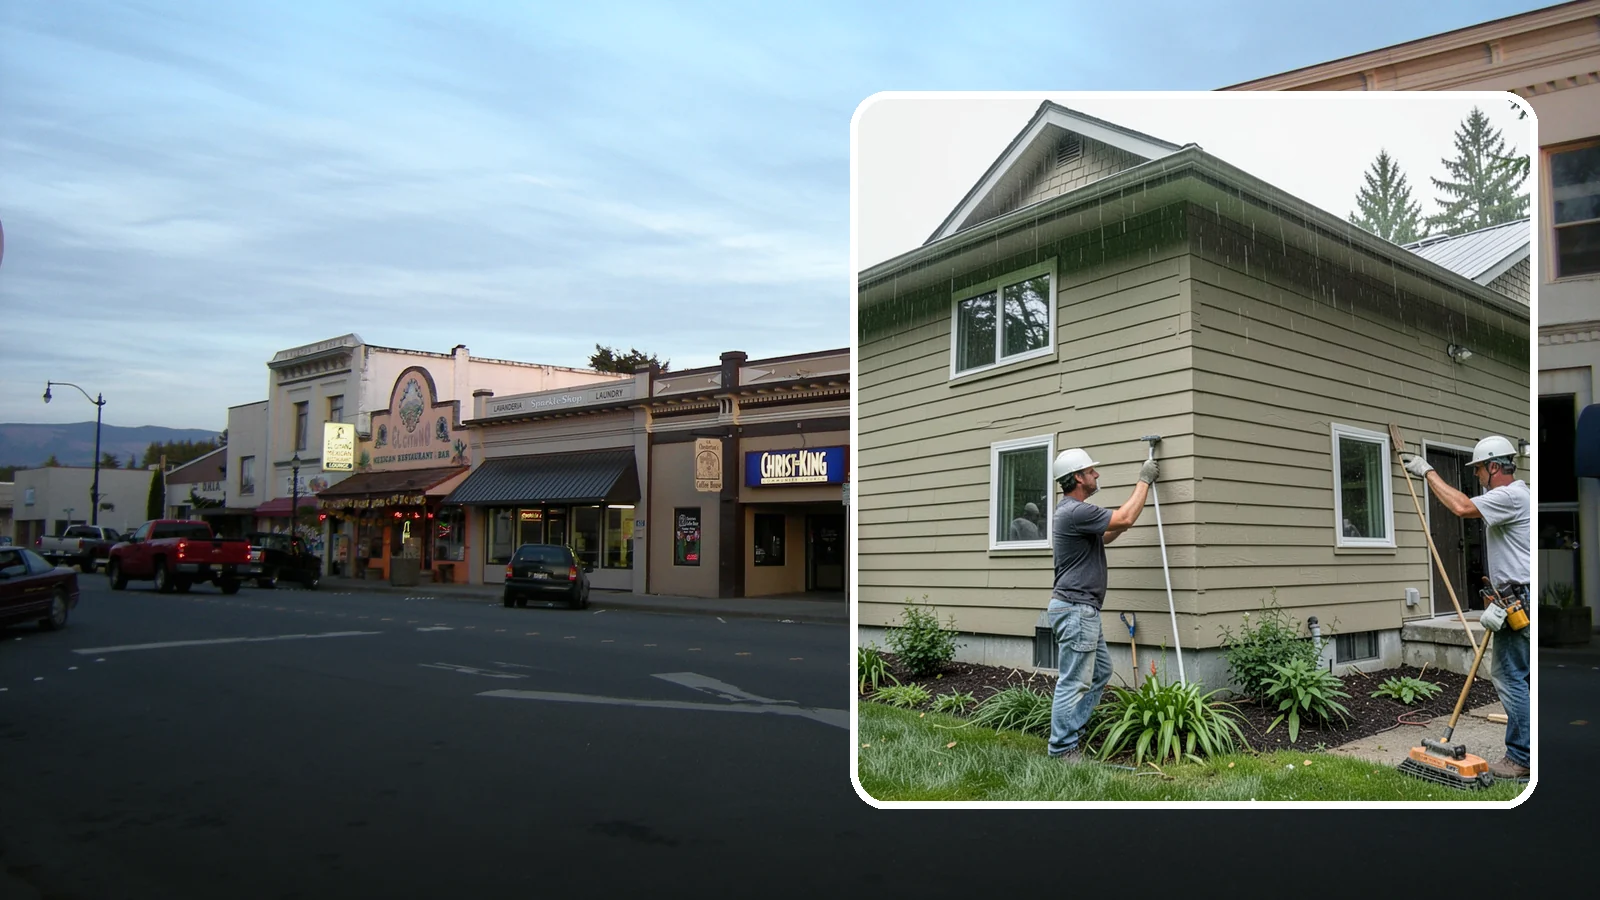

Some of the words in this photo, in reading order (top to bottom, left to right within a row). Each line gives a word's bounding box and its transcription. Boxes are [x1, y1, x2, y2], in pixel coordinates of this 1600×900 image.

[595, 389, 623, 399] LAUNDRY
[493, 402, 522, 412] LAVANDERIA
[531, 397, 561, 409] Sparkle
[562, 394, 582, 404] Shop
[373, 455, 396, 464] MEXICAN
[397, 451, 433, 462] RESTAURANT
[438, 450, 450, 459] BAR
[761, 452, 797, 477] CHRIST
[799, 450, 827, 476] KING
